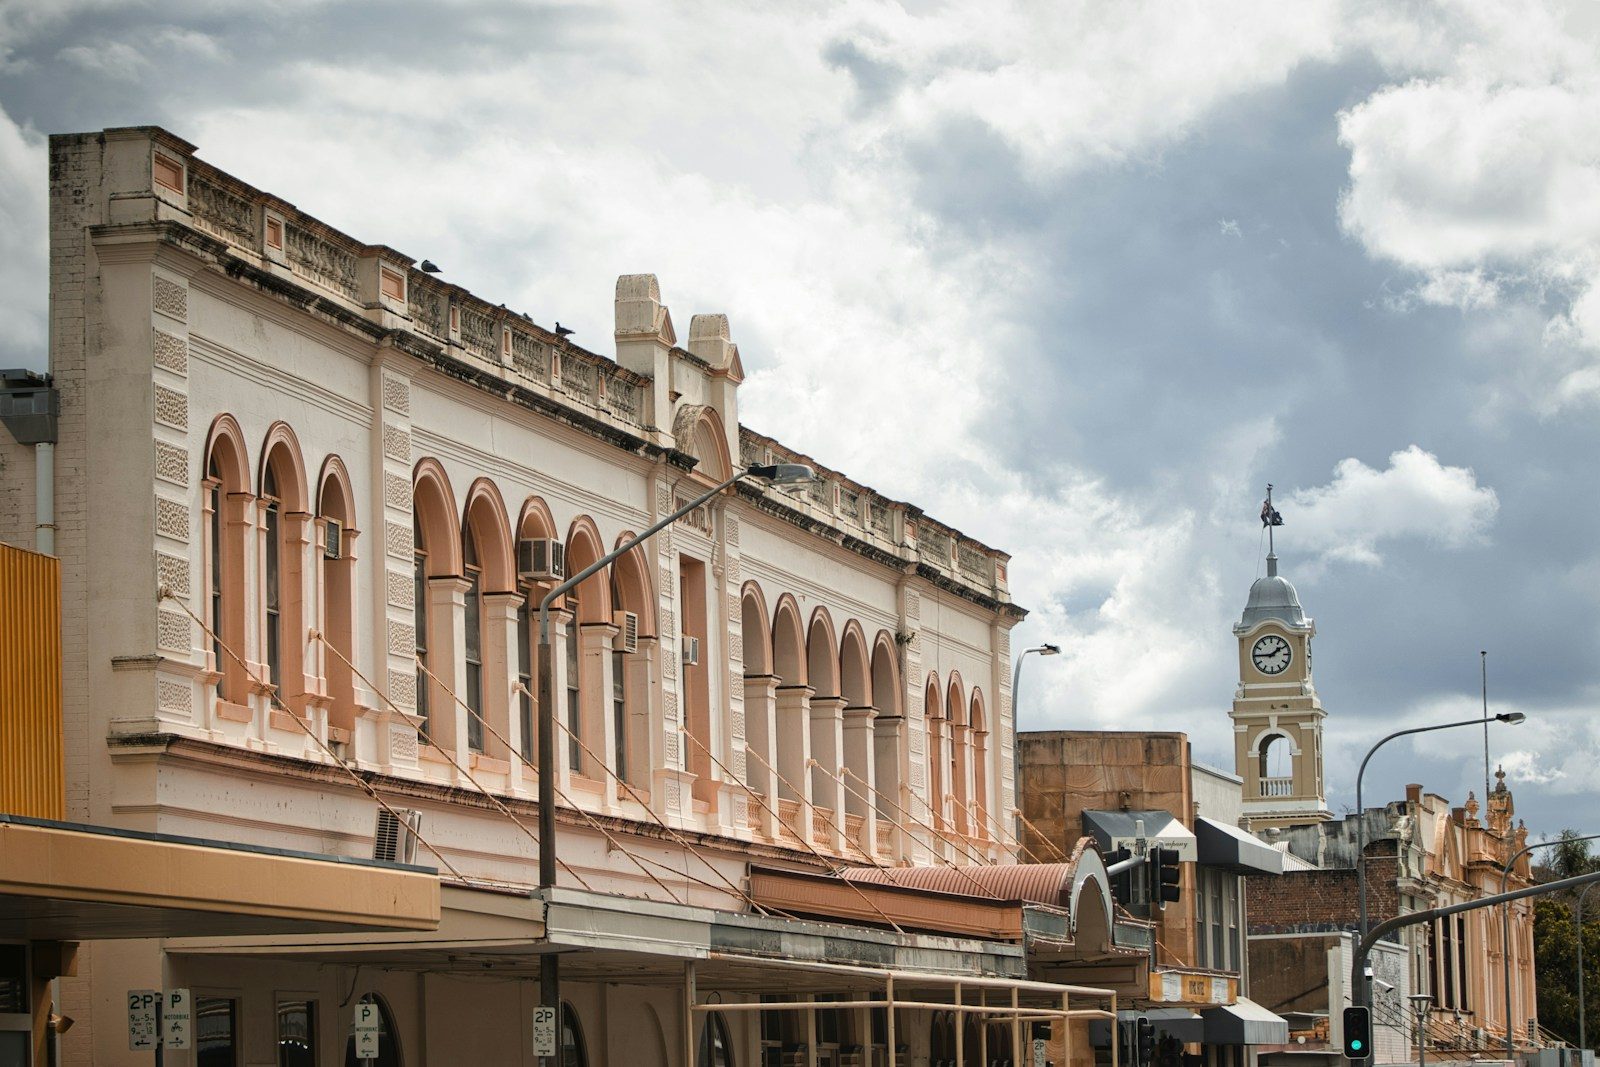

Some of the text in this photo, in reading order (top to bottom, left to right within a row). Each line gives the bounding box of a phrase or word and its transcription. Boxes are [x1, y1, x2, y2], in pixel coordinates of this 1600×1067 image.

[130, 994, 154, 1010] 2P
[171, 994, 182, 1009] P
[362, 1009, 371, 1022] P
[535, 1011, 553, 1023] 2P
[1034, 1042, 1045, 1051] 2P
